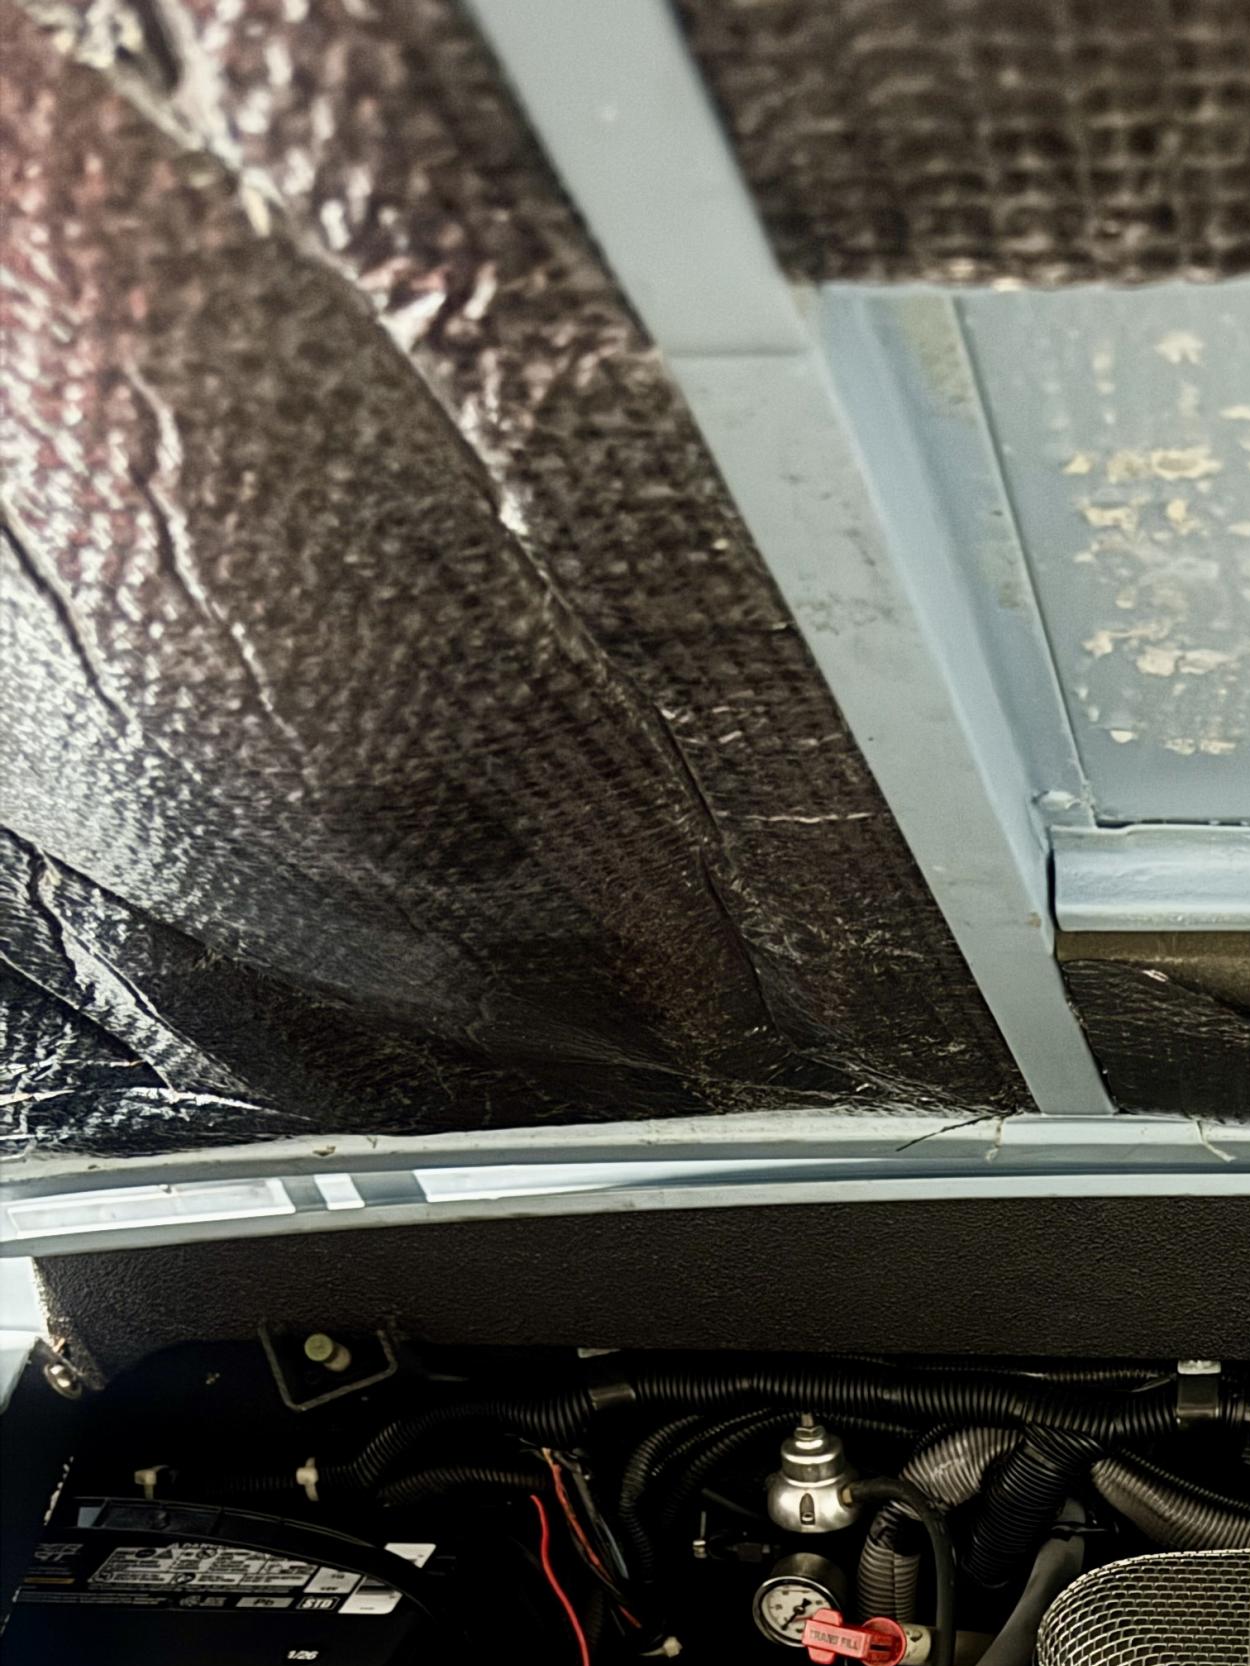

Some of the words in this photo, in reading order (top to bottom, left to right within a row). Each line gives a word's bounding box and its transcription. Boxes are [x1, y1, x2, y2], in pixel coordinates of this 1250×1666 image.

[810, 1629, 839, 1646] TRANS
[841, 1636, 859, 1651] FILL
[287, 1650, 319, 1661] 1/26
